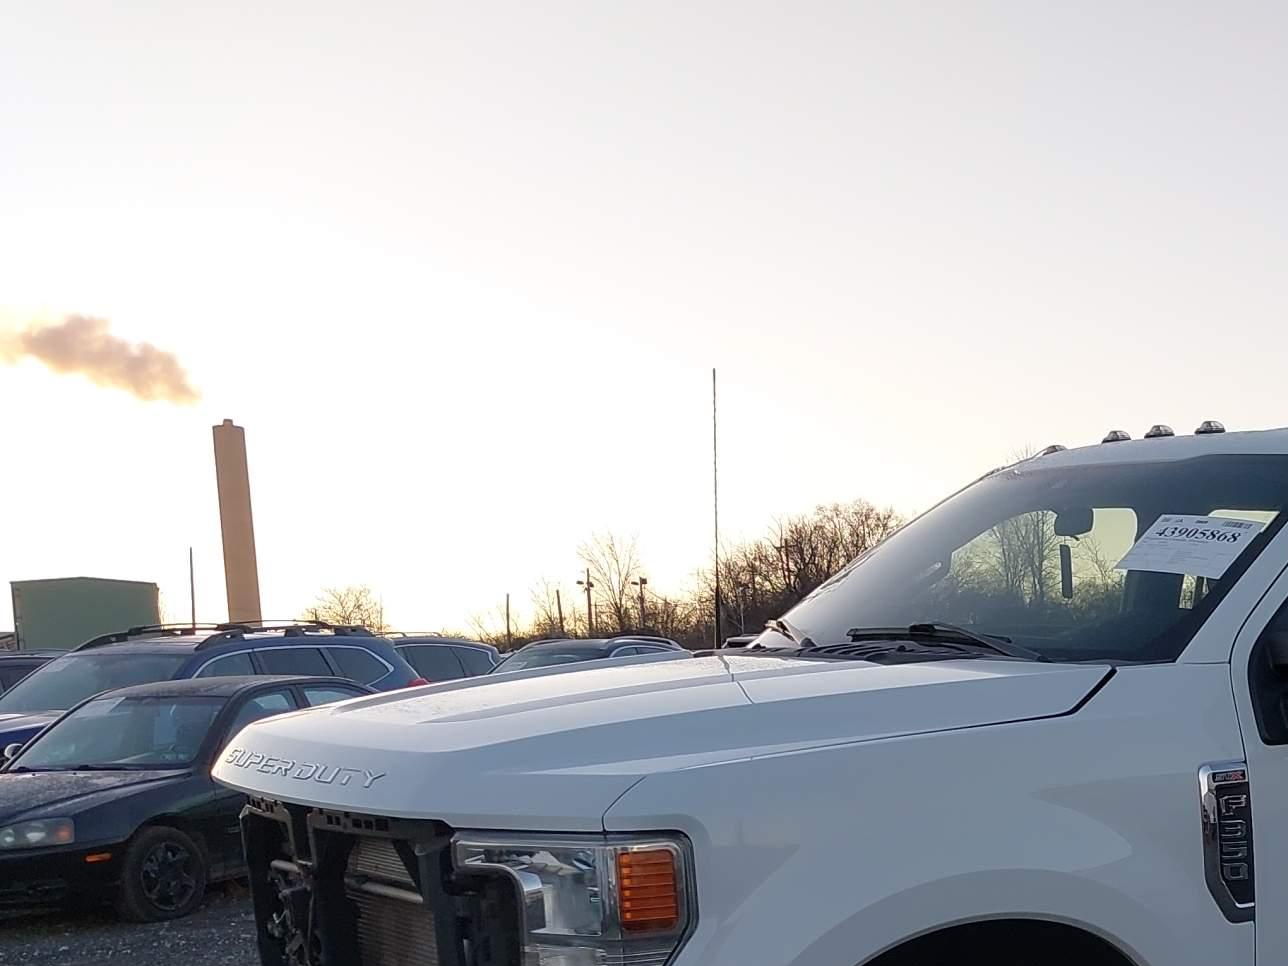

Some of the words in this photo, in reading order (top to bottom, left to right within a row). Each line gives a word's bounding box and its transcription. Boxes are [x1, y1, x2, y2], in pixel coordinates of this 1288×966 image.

[1155, 526, 1242, 543] 43905868
[225, 747, 296, 776] SUPER
[292, 762, 387, 788] DUTY
